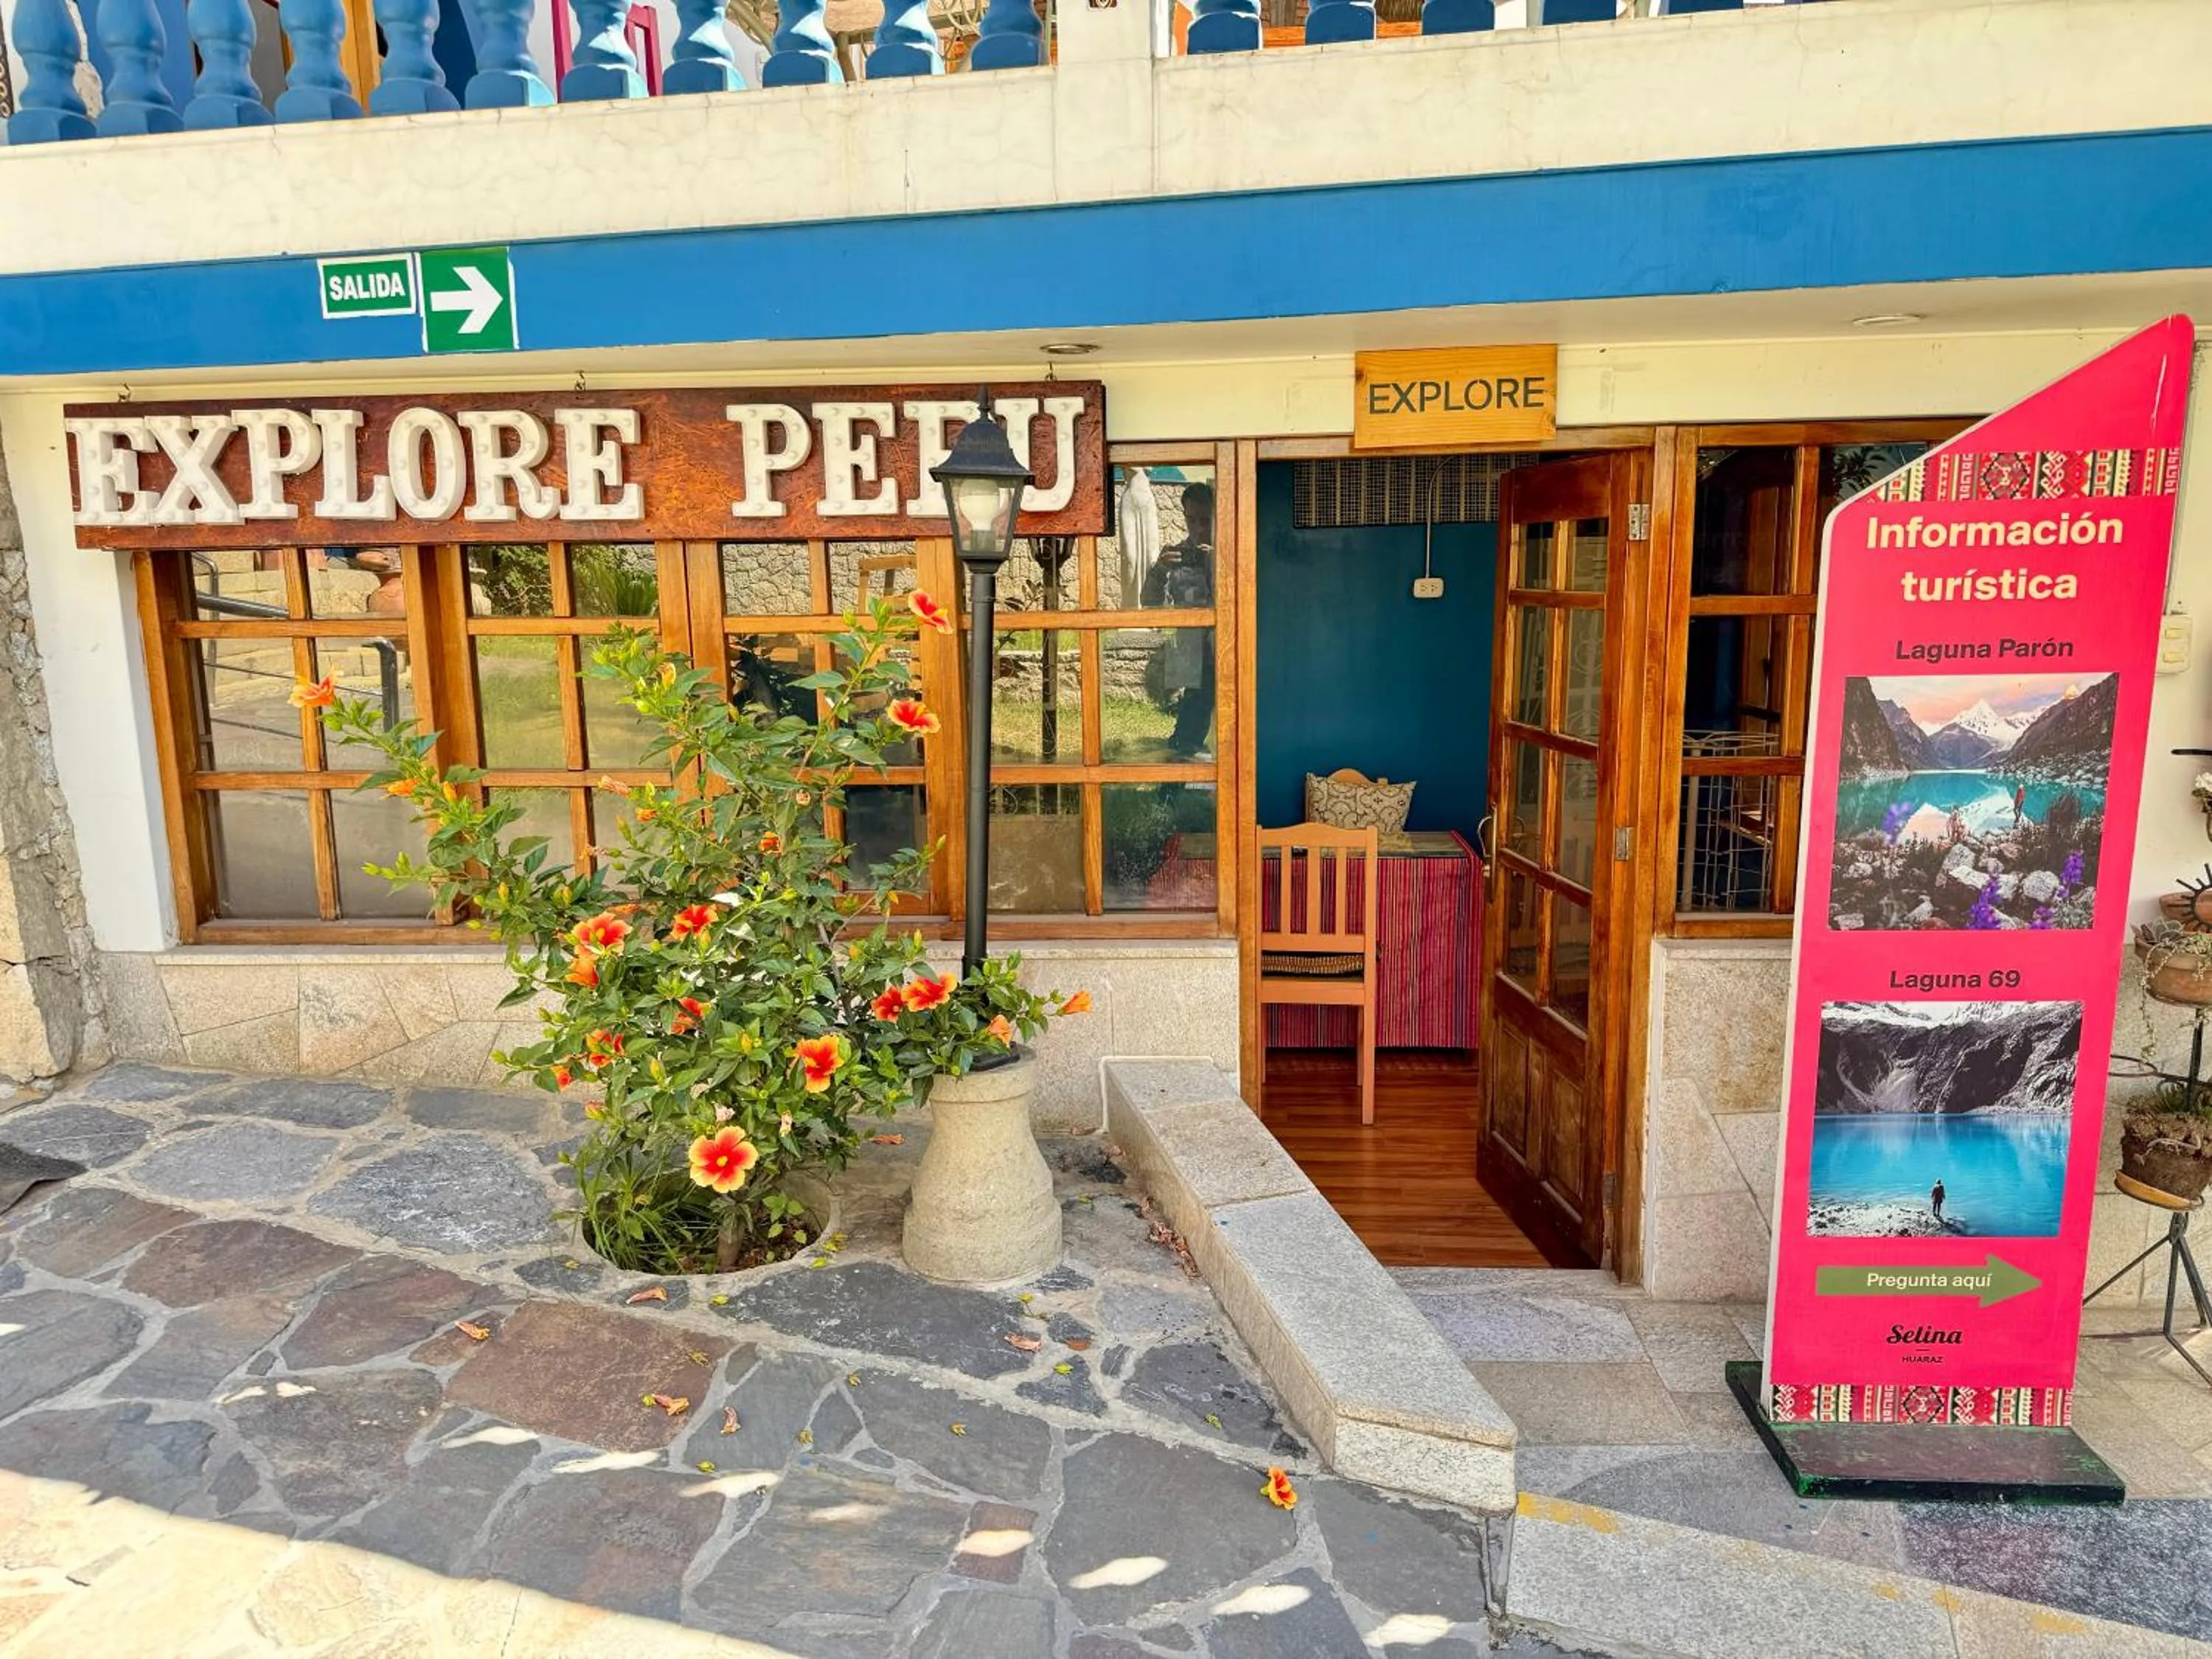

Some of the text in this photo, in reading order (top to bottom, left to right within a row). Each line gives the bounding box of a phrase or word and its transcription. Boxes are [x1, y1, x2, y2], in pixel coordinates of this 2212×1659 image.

[329, 271, 406, 301] SALIDA
[1368, 377, 1545, 414] EXPLORE
[64, 408, 644, 526] EXPLORE
[1867, 512, 2123, 549] Información
[1902, 568, 2077, 602] turística
[1896, 639, 2073, 664] Laguna Parón
[1890, 970, 2021, 992] Laguna 69
[1867, 1273, 1992, 1290] Pregunta aquí
[1886, 1324, 1963, 1345] Selina
